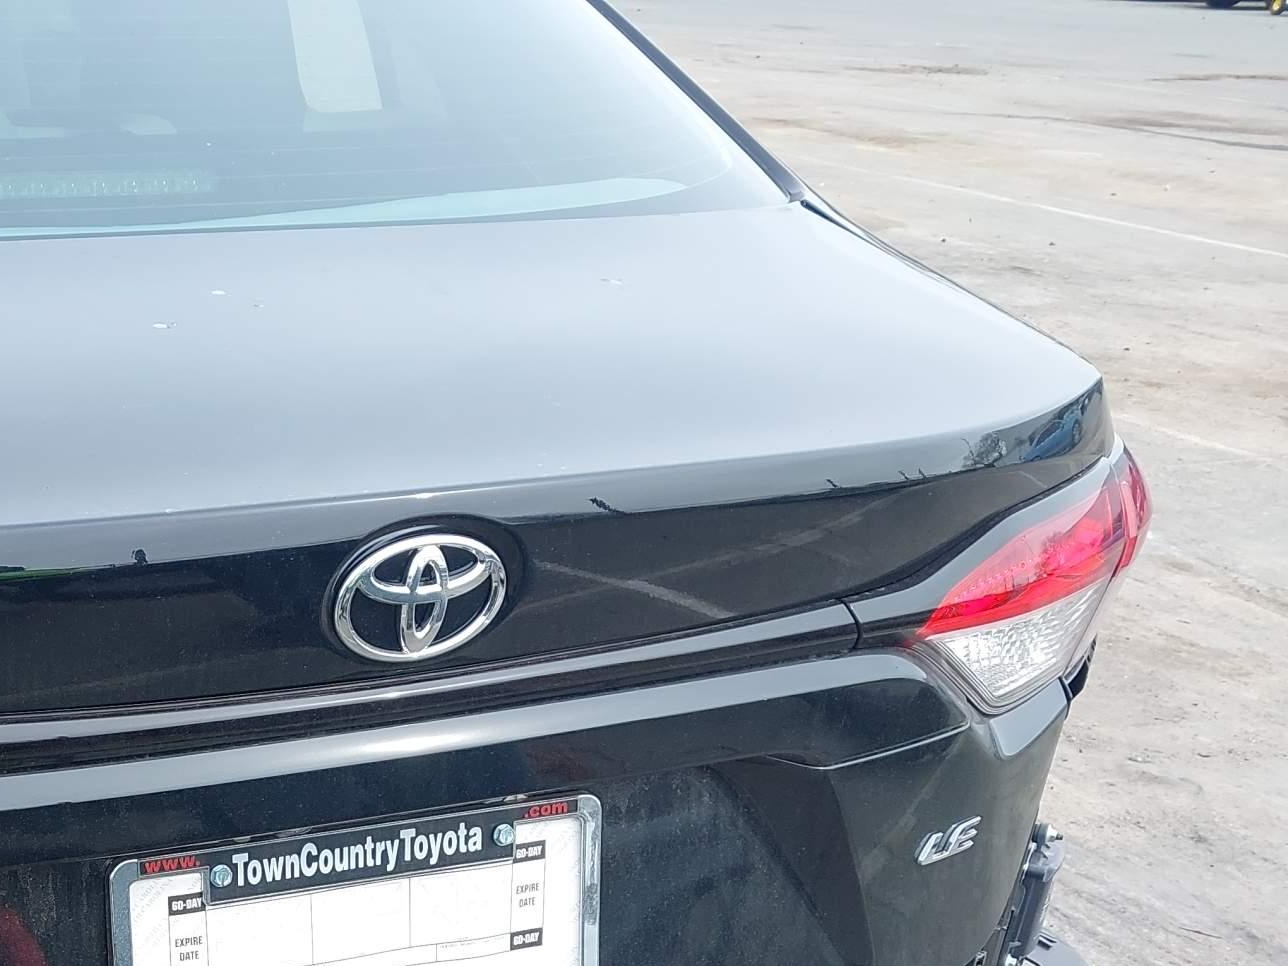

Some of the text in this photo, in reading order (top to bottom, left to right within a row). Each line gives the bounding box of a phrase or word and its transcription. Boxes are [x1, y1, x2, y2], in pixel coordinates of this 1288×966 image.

[144, 801, 569, 887] www. TownCountryToyota .com
[914, 815, 981, 866] LE
[515, 845, 543, 859] 60-DAY
[516, 882, 540, 895] EXPIRE
[172, 898, 203, 912] 60-DAY
[519, 896, 536, 908] DATE
[175, 936, 203, 948] EXPIRE
[513, 931, 540, 946] 60-DAY
[179, 950, 200, 962] DATE
